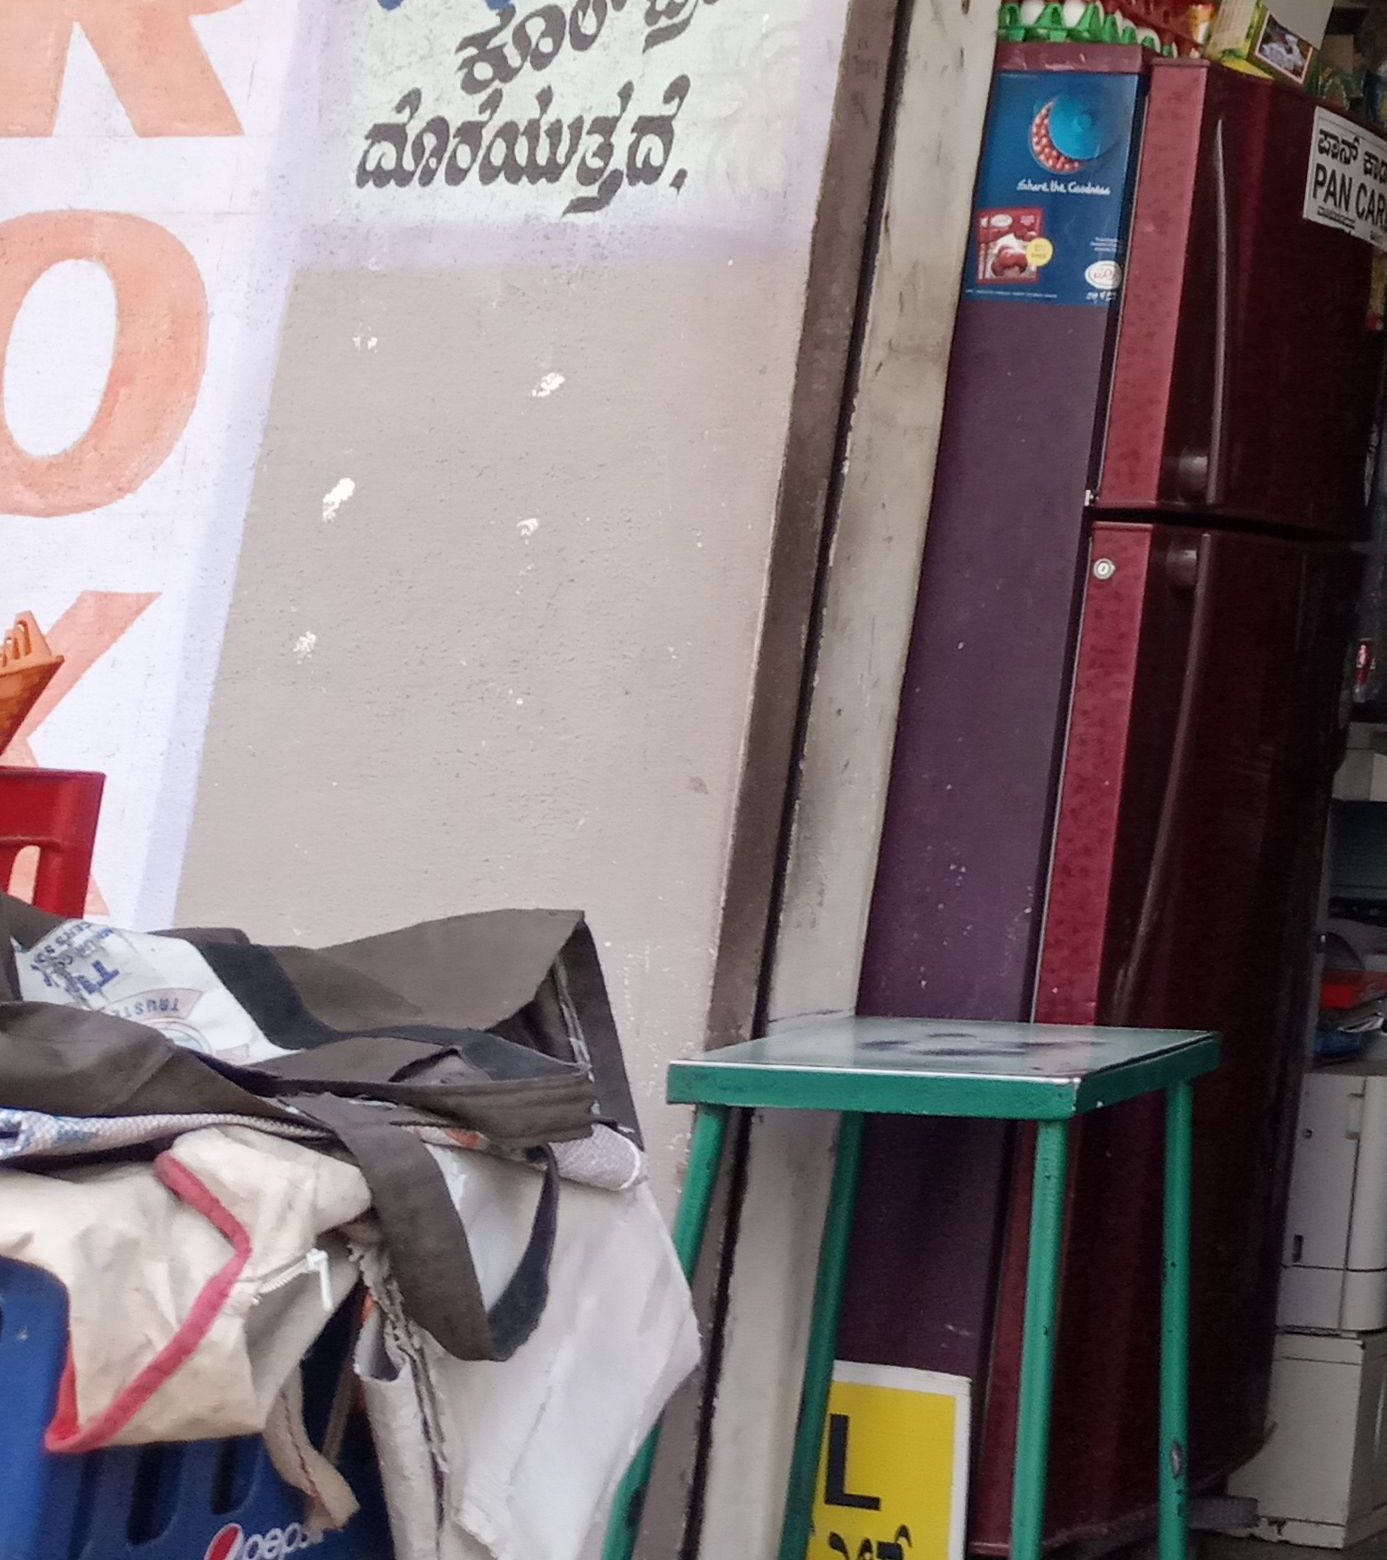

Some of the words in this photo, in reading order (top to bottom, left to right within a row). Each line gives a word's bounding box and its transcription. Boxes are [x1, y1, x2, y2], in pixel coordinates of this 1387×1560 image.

[1318, 128, 1360, 165] ಪಾನ್
[1050, 180, 1067, 193] the
[1067, 181, 1111, 196] Goodness
[1312, 162, 1353, 213] PAN
